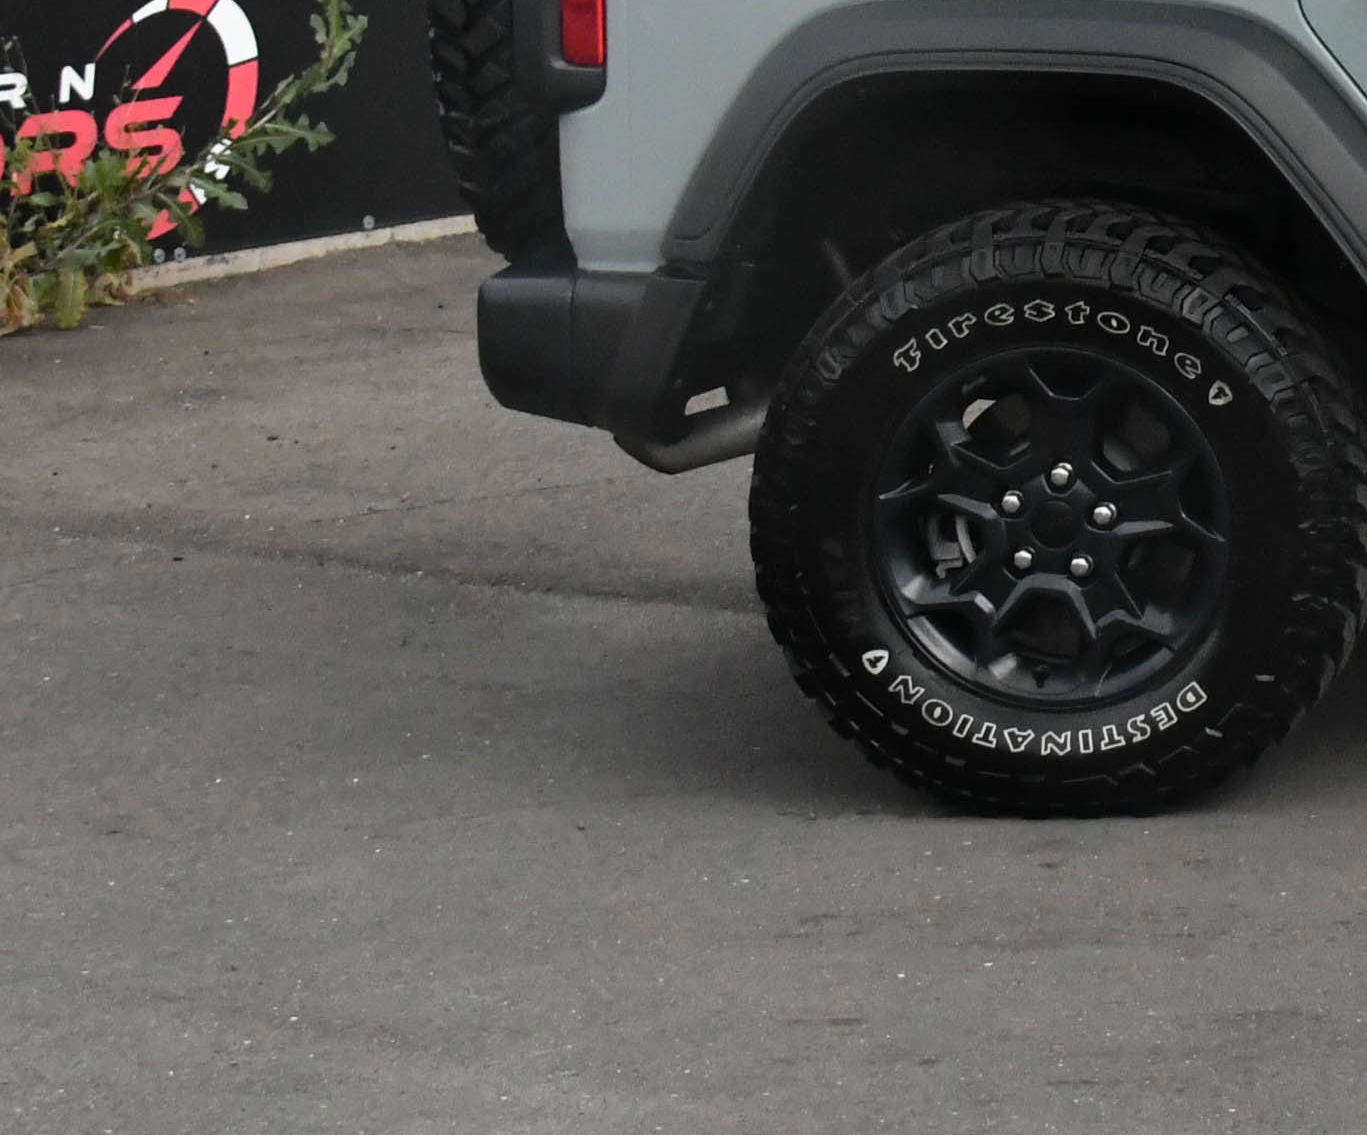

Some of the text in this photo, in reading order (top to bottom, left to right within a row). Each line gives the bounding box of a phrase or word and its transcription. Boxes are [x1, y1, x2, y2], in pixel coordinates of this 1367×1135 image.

[0, 95, 184, 196] RS
[893, 299, 1202, 380] Firestone
[888, 674, 1208, 756] DESTINATION
